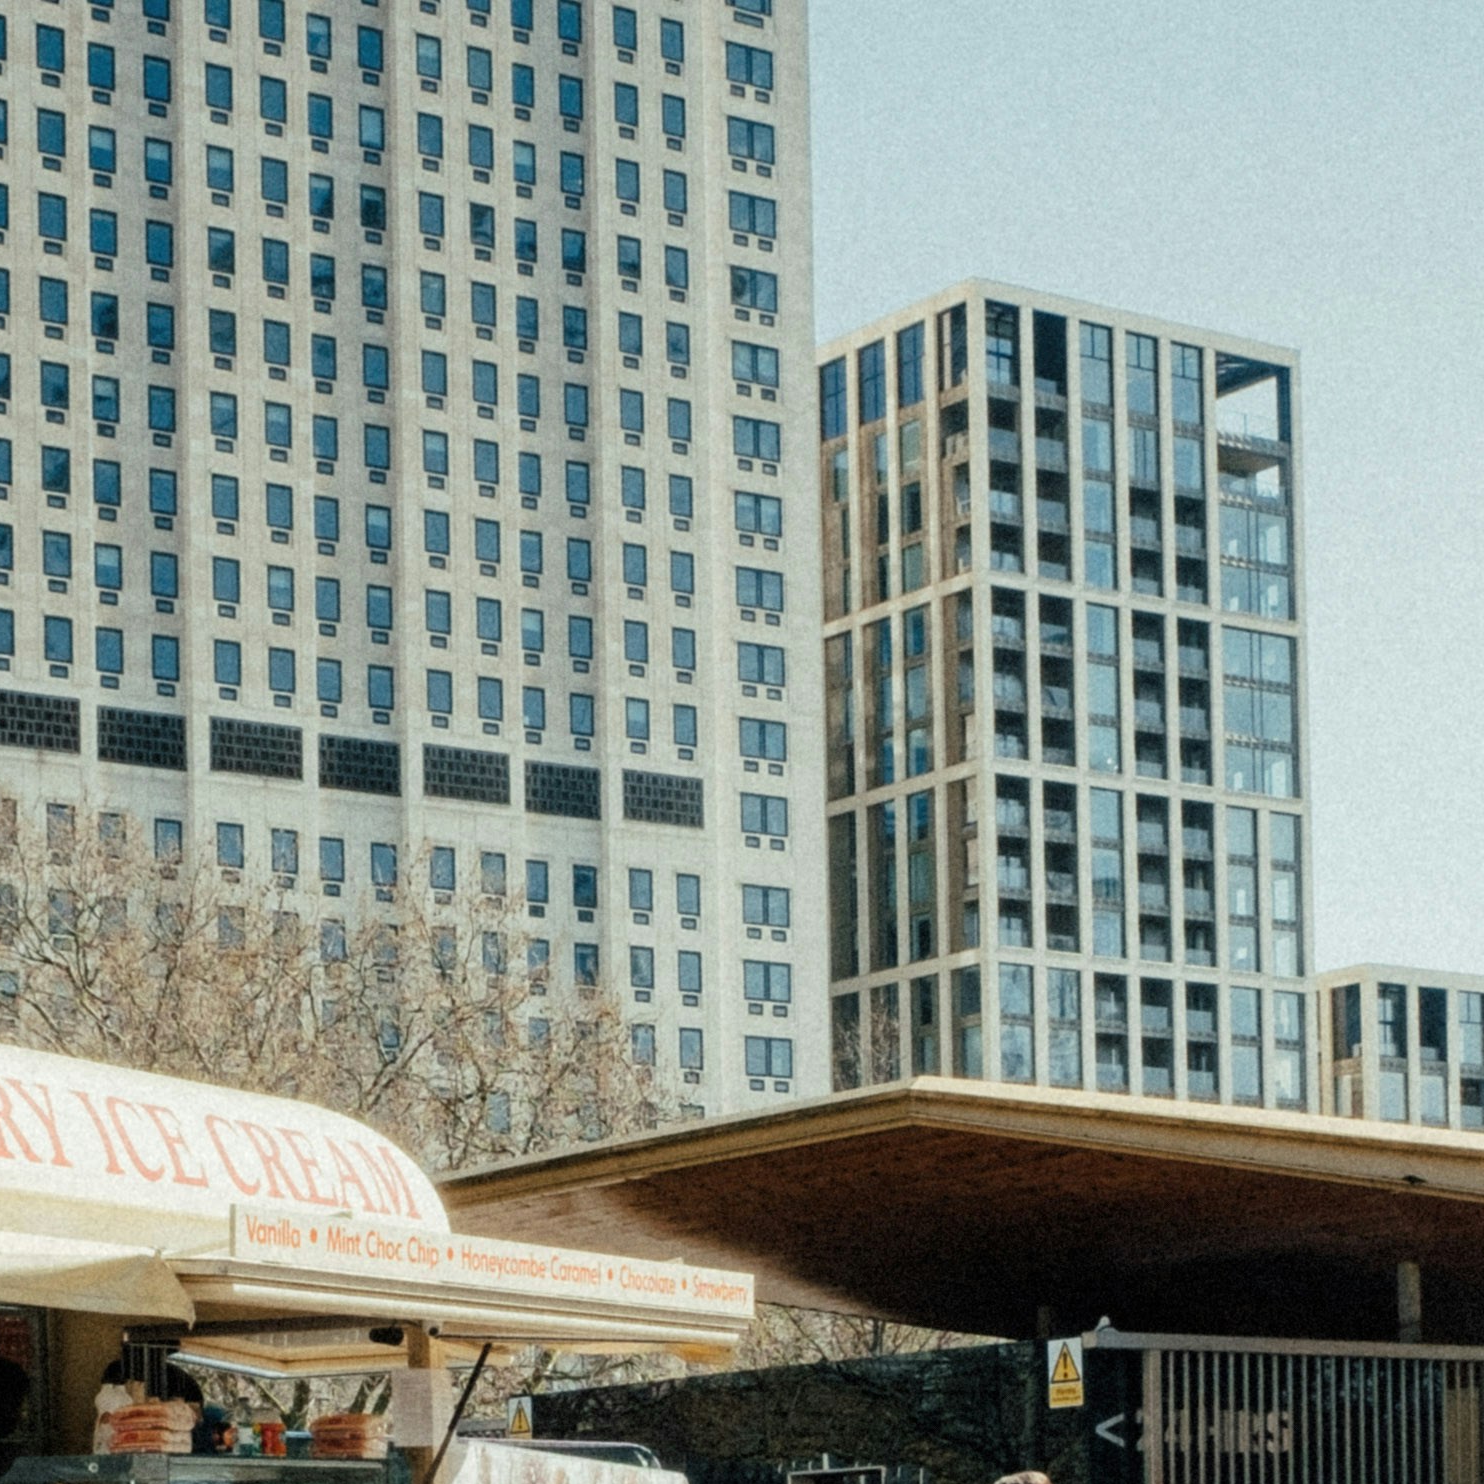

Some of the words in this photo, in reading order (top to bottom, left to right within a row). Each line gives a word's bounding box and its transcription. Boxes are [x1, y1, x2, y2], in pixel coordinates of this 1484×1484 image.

[68, 1089, 210, 1188] ICE
[204, 1113, 421, 1220] CREAM
[246, 1214, 302, 1249] Vanilla
[327, 1226, 361, 1256] Mint
[366, 1230, 403, 1261] Choc
[408, 1235, 439, 1268] Chip
[461, 1244, 546, 1279] Honeycombe
[550, 1256, 602, 1284] Caramel
[620, 1264, 675, 1295] Chocolate
[693, 1273, 747, 1304] Strawberry
